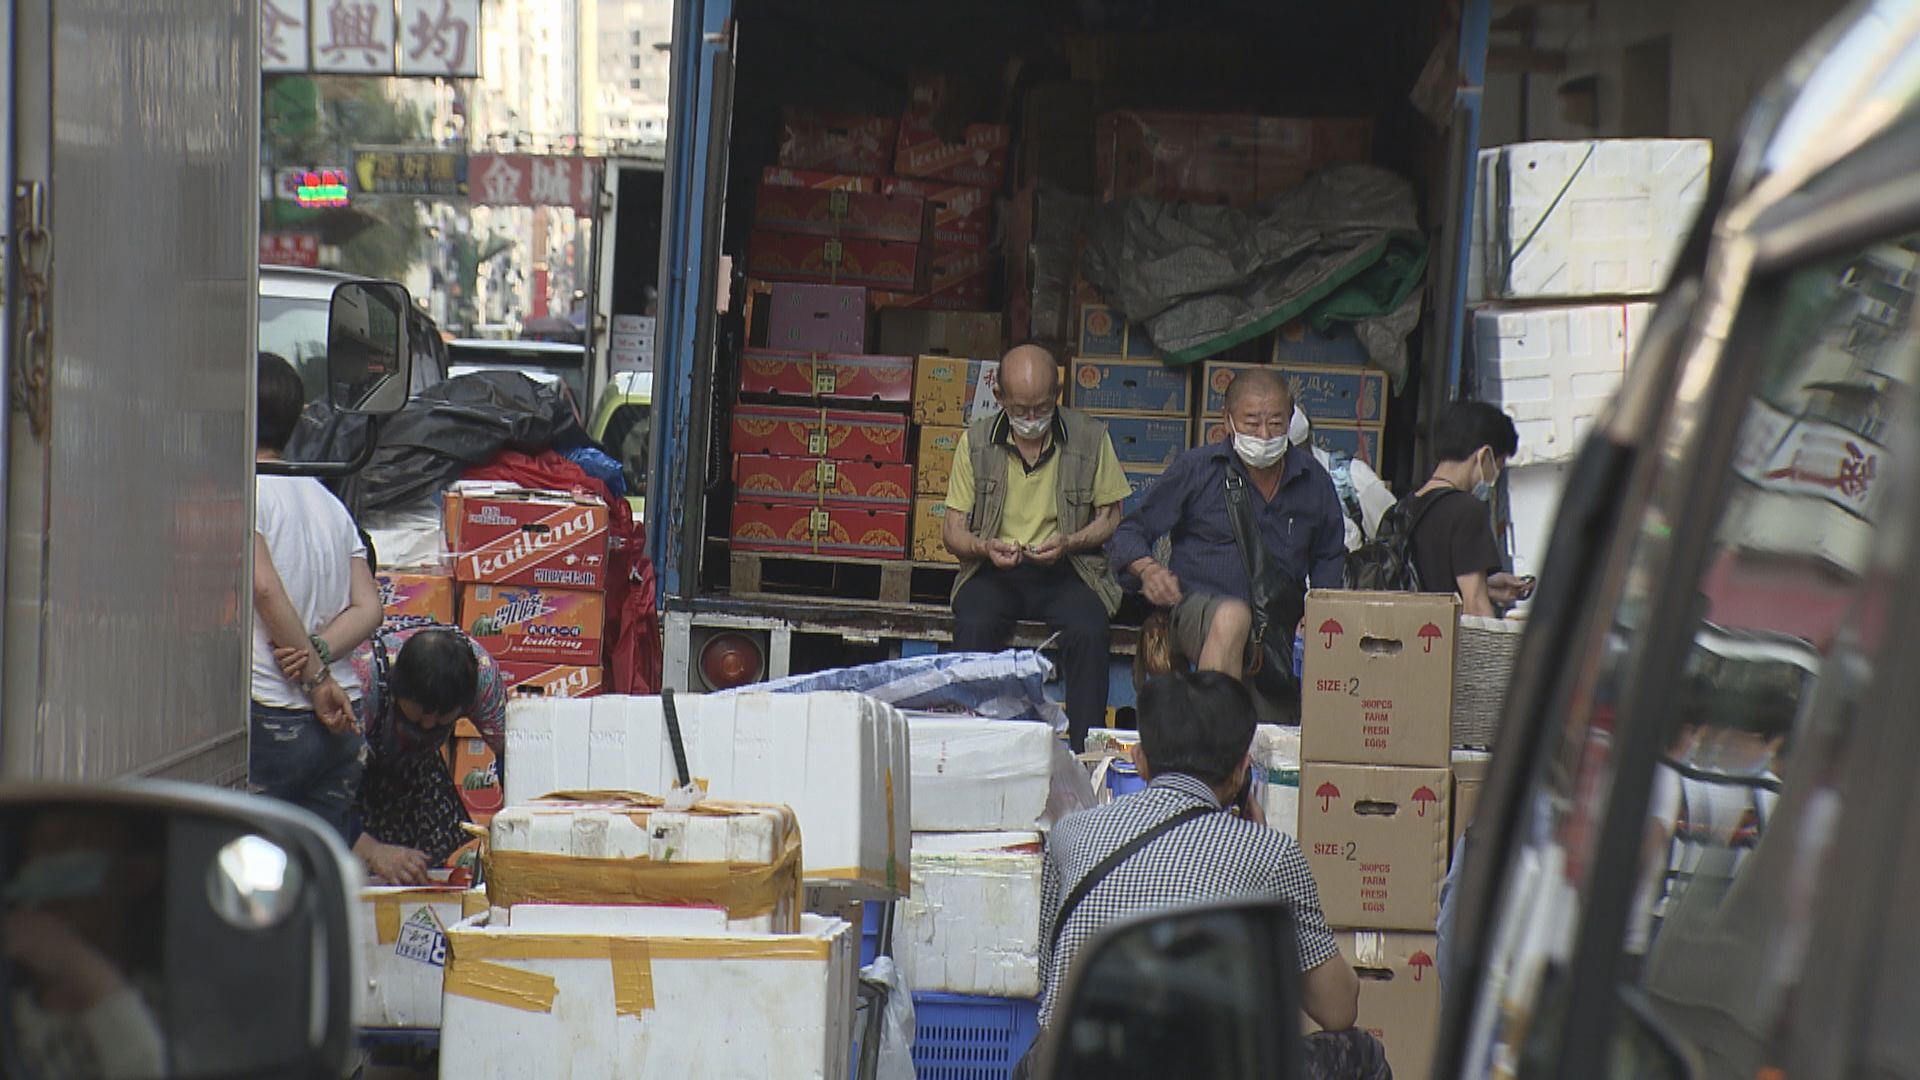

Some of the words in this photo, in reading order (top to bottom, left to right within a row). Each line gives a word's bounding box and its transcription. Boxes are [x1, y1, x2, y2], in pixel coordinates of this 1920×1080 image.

[471, 509, 596, 581] kailong
[1364, 712, 1389, 722] FARM
[1362, 725, 1390, 736] FRESH
[1364, 738, 1387, 749] EGGS
[1362, 876, 1387, 886] FARM
[1360, 888, 1388, 899] FRESH
[1362, 902, 1386, 913] EGGS
